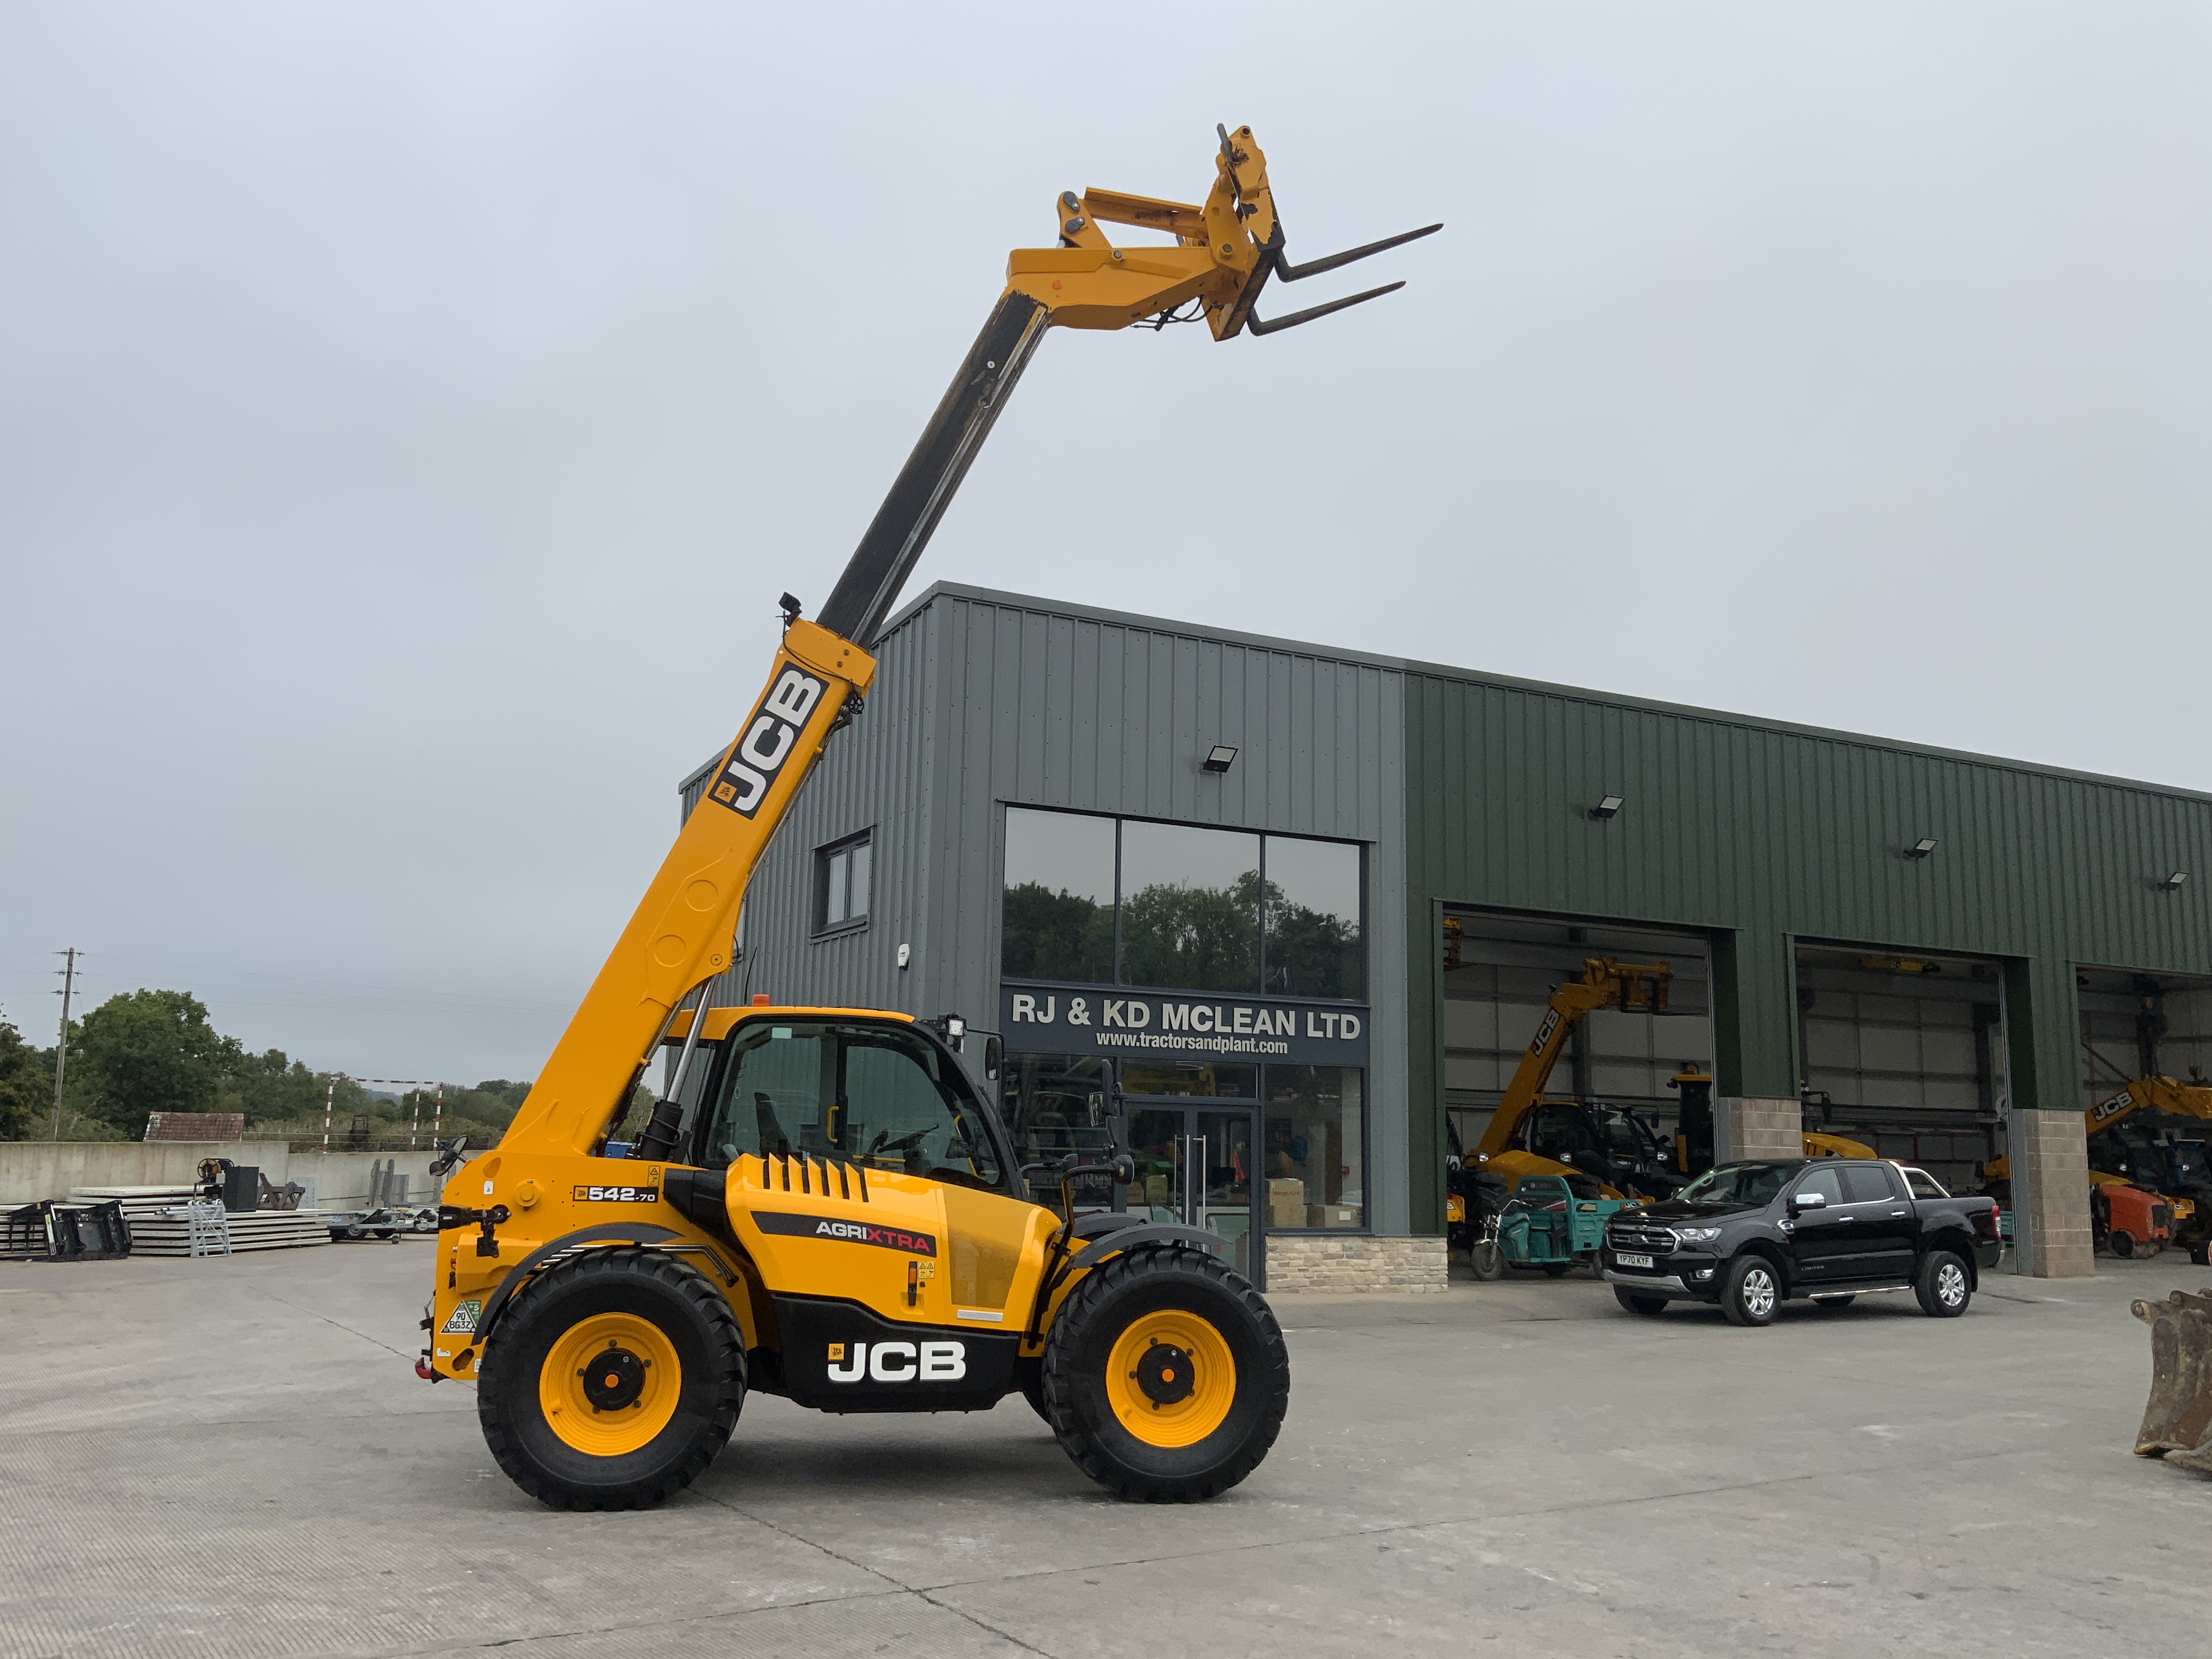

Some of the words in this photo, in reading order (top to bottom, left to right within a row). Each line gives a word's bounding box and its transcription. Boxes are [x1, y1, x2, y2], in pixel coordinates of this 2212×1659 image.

[728, 670, 821, 811] JCB
[1013, 994, 1055, 1024] RJ
[1068, 997, 1092, 1025] &
[1103, 999, 1150, 1028] KD
[1162, 1003, 1295, 1036] MCLEAN
[1307, 1012, 1361, 1040] LTD
[1535, 1009, 1559, 1056] JCB
[1096, 1032, 1288, 1054] www.tractorsandplant.com
[2096, 1092, 2133, 1120] JCB
[589, 1187, 656, 1201] 542-70
[816, 1221, 931, 1252] AGRIXTRA
[1619, 1254, 1635, 1263] YP70
[1637, 1256, 1649, 1265] KYF
[827, 1341, 967, 1382] JCB
